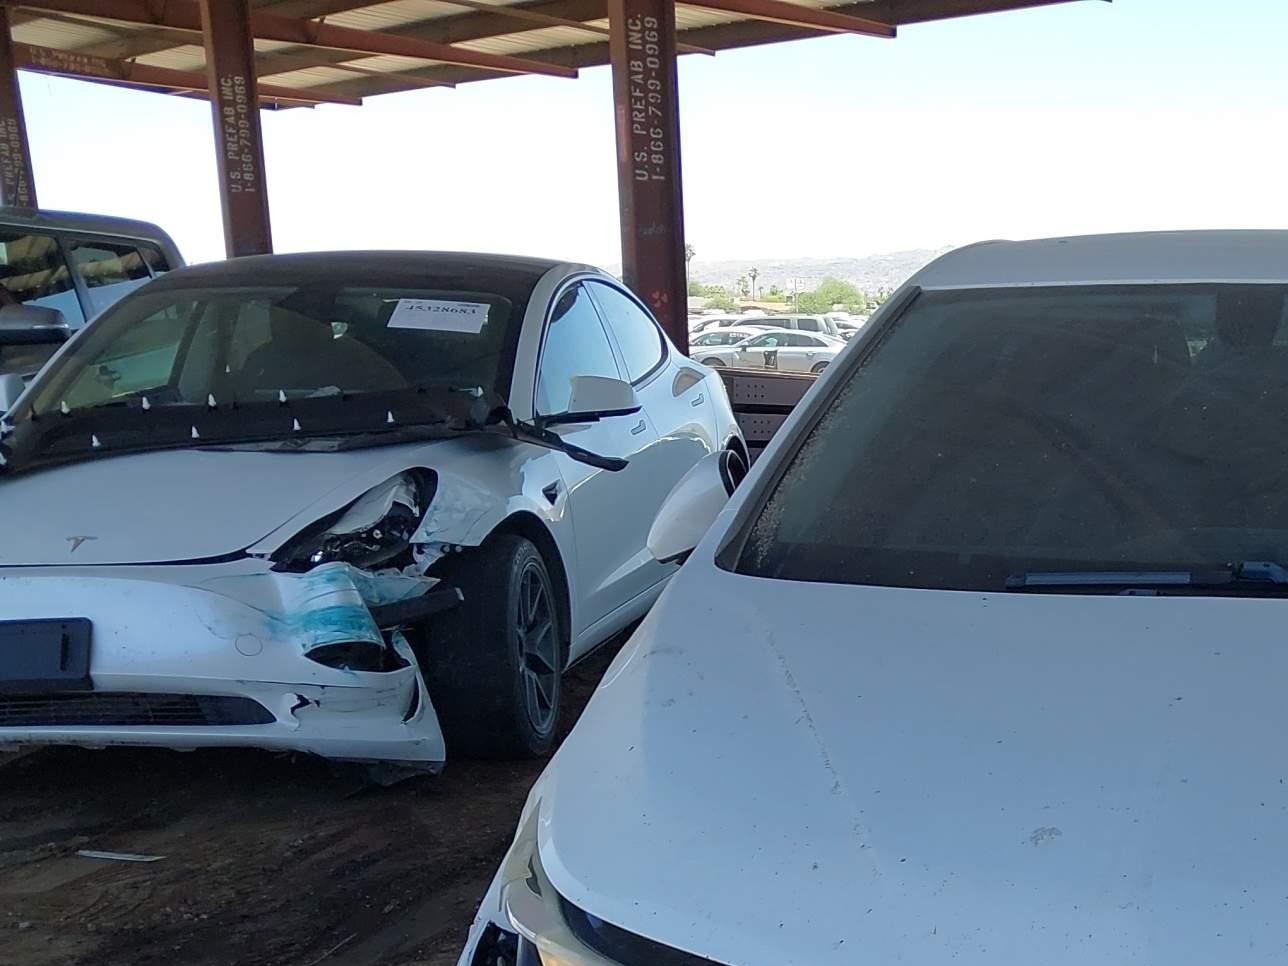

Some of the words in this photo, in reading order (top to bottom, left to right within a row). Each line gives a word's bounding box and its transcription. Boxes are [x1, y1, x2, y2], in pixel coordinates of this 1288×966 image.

[627, 14, 642, 51] INC.
[629, 60, 647, 135] PREFAB
[643, 16, 665, 181] 1-866-799-0969
[223, 107, 241, 160] PREFAB
[634, 146, 649, 182] U.S.
